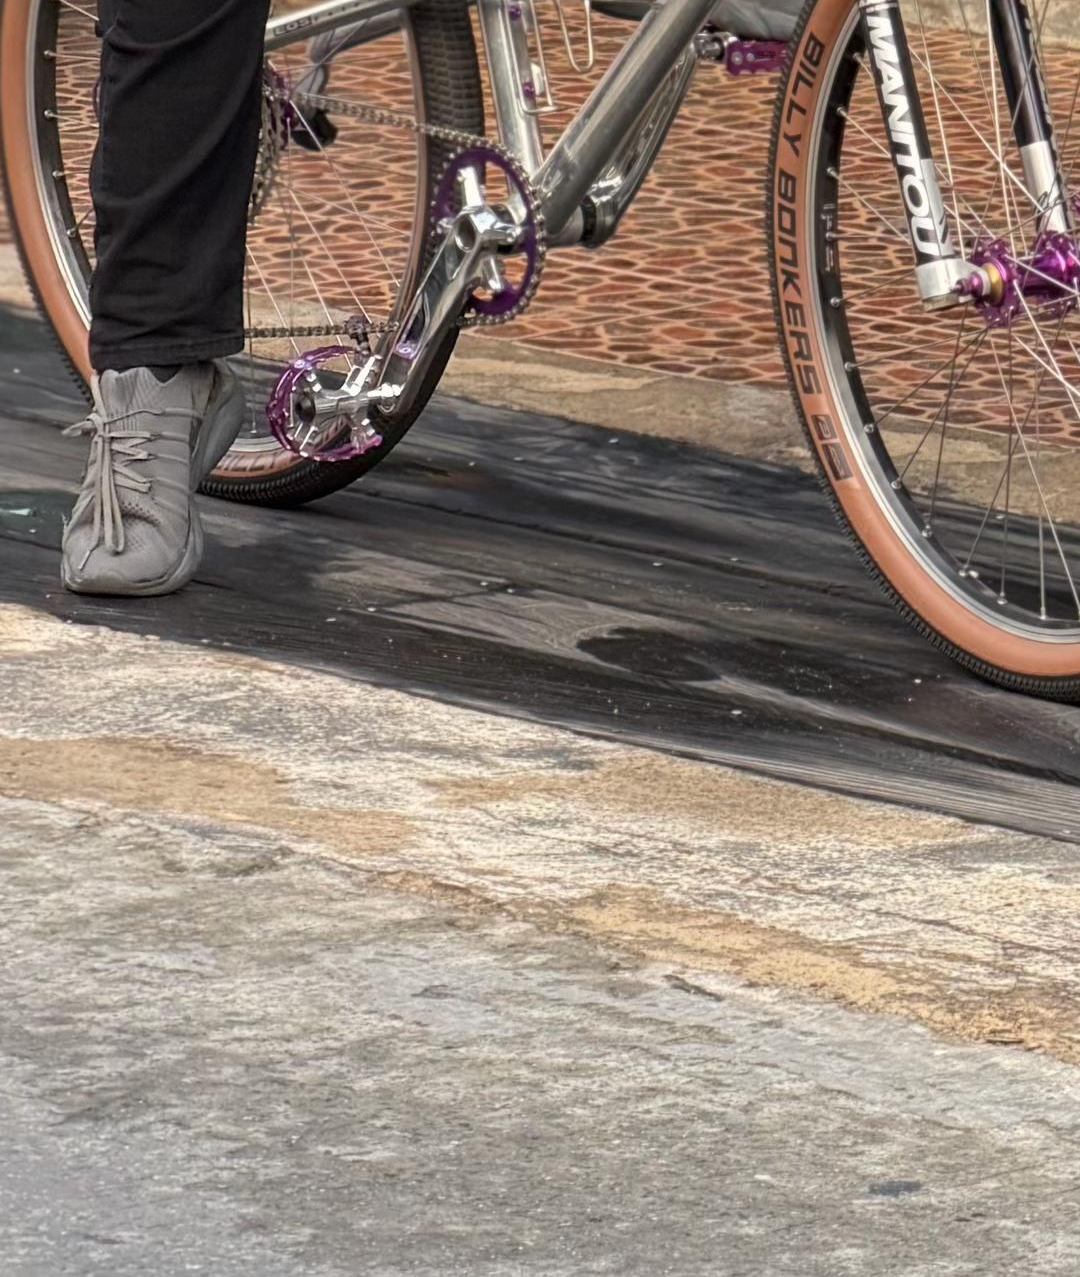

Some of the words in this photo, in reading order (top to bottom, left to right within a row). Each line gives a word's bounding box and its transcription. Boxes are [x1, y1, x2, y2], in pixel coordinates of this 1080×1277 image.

[784, 30, 825, 158] BILLY
[866, 15, 941, 257] MANITOU
[777, 166, 823, 395] BONKERS
